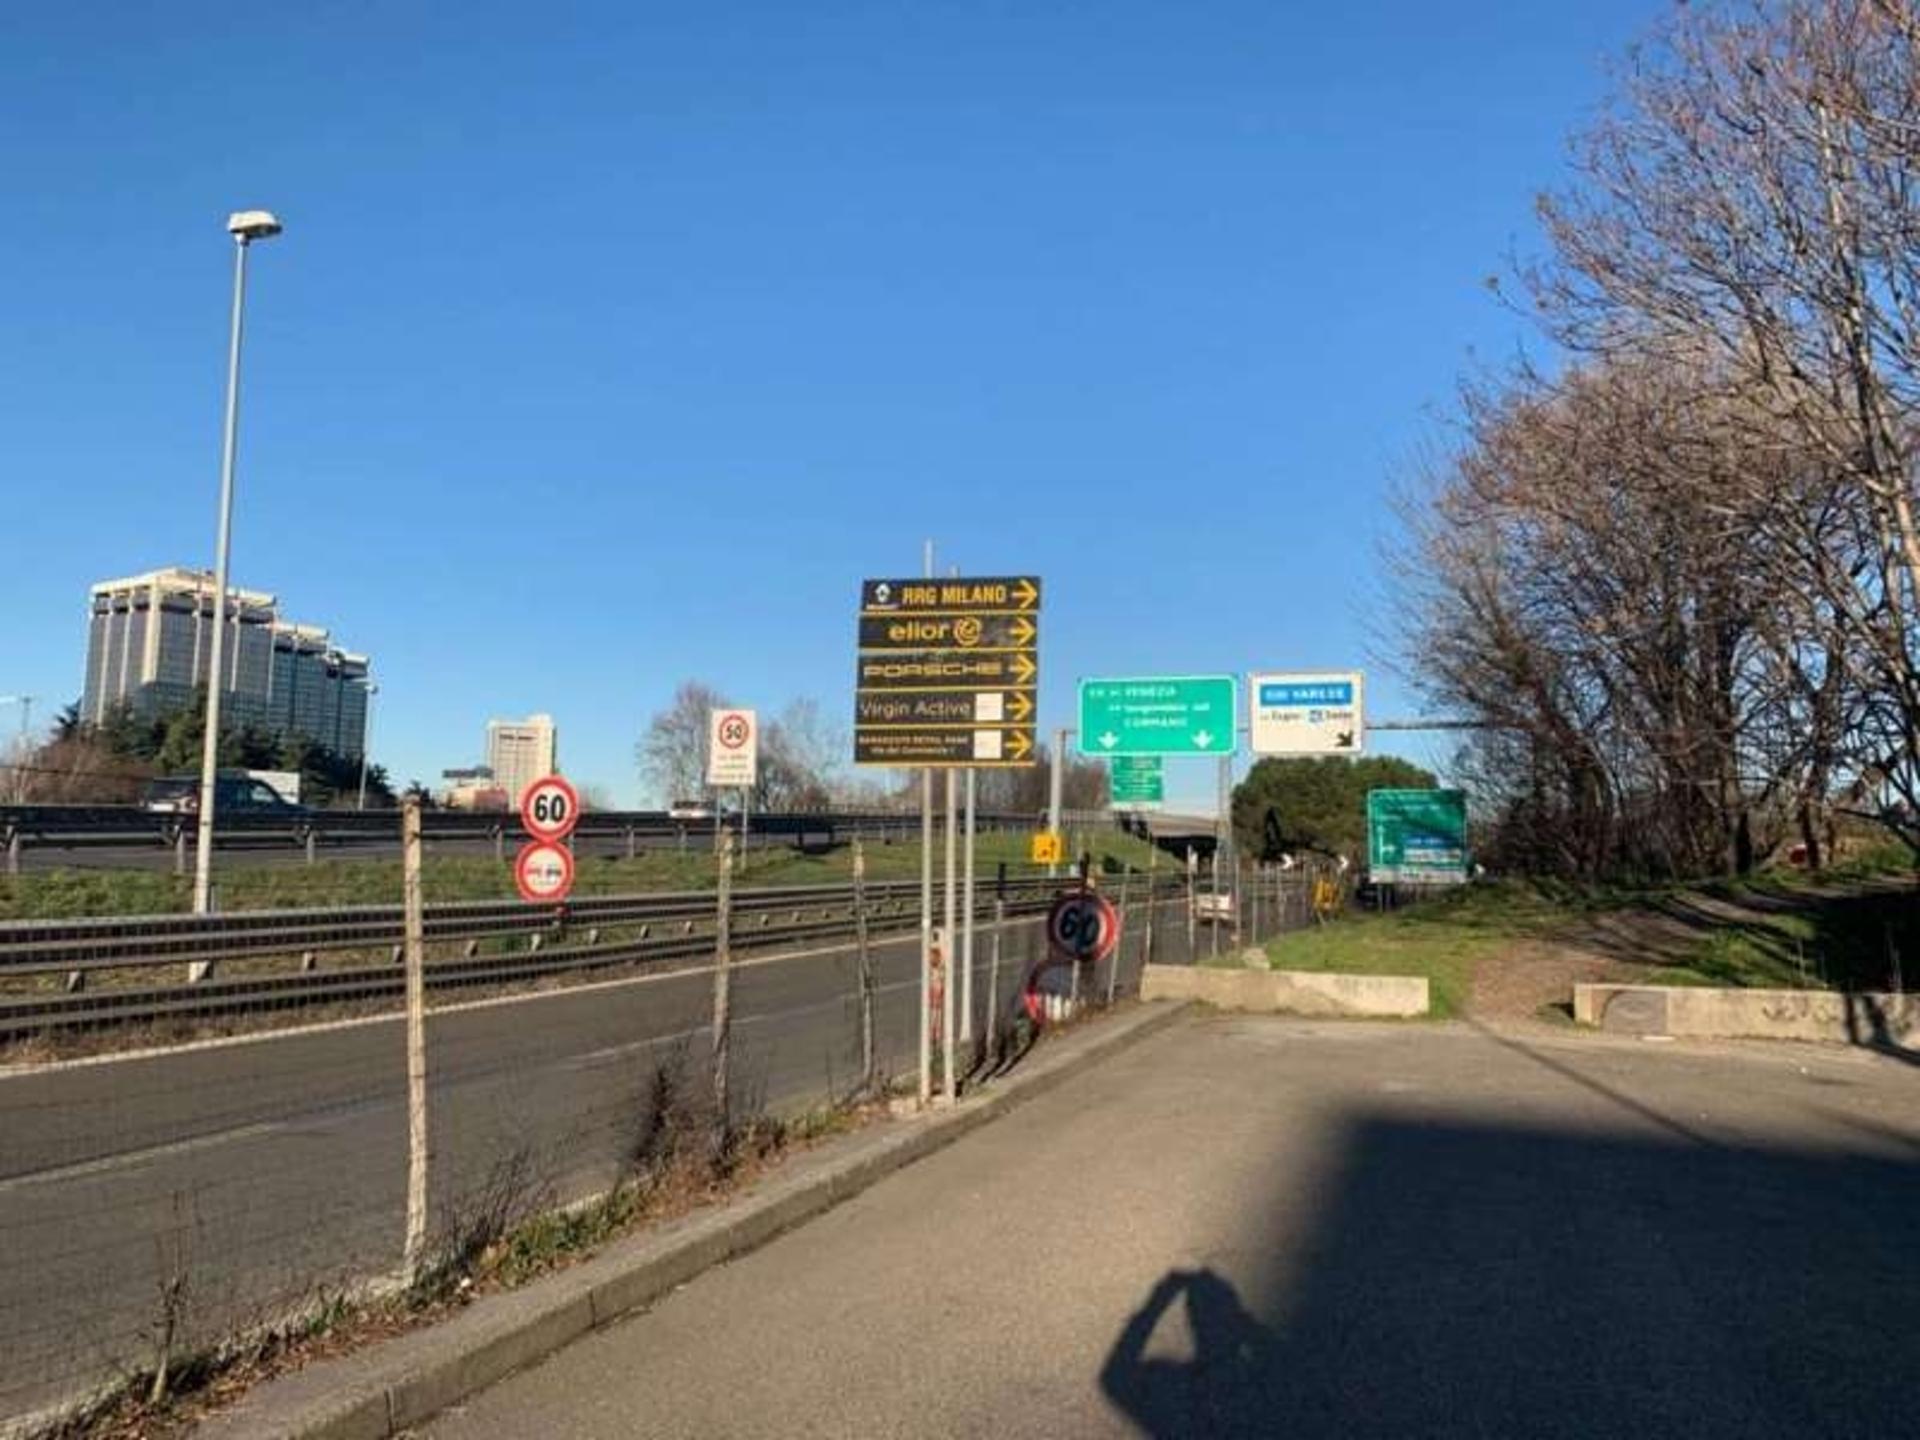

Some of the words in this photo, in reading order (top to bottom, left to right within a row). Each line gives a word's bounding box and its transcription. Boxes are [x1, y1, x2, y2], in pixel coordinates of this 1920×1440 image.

[902, 586, 937, 604] RRG
[942, 584, 1007, 604] MILANO
[863, 662, 1001, 678] PORSCHE
[860, 698, 910, 719] Virgin
[914, 698, 971, 717] Active
[725, 723, 742, 740] 50
[534, 794, 566, 823] 60
